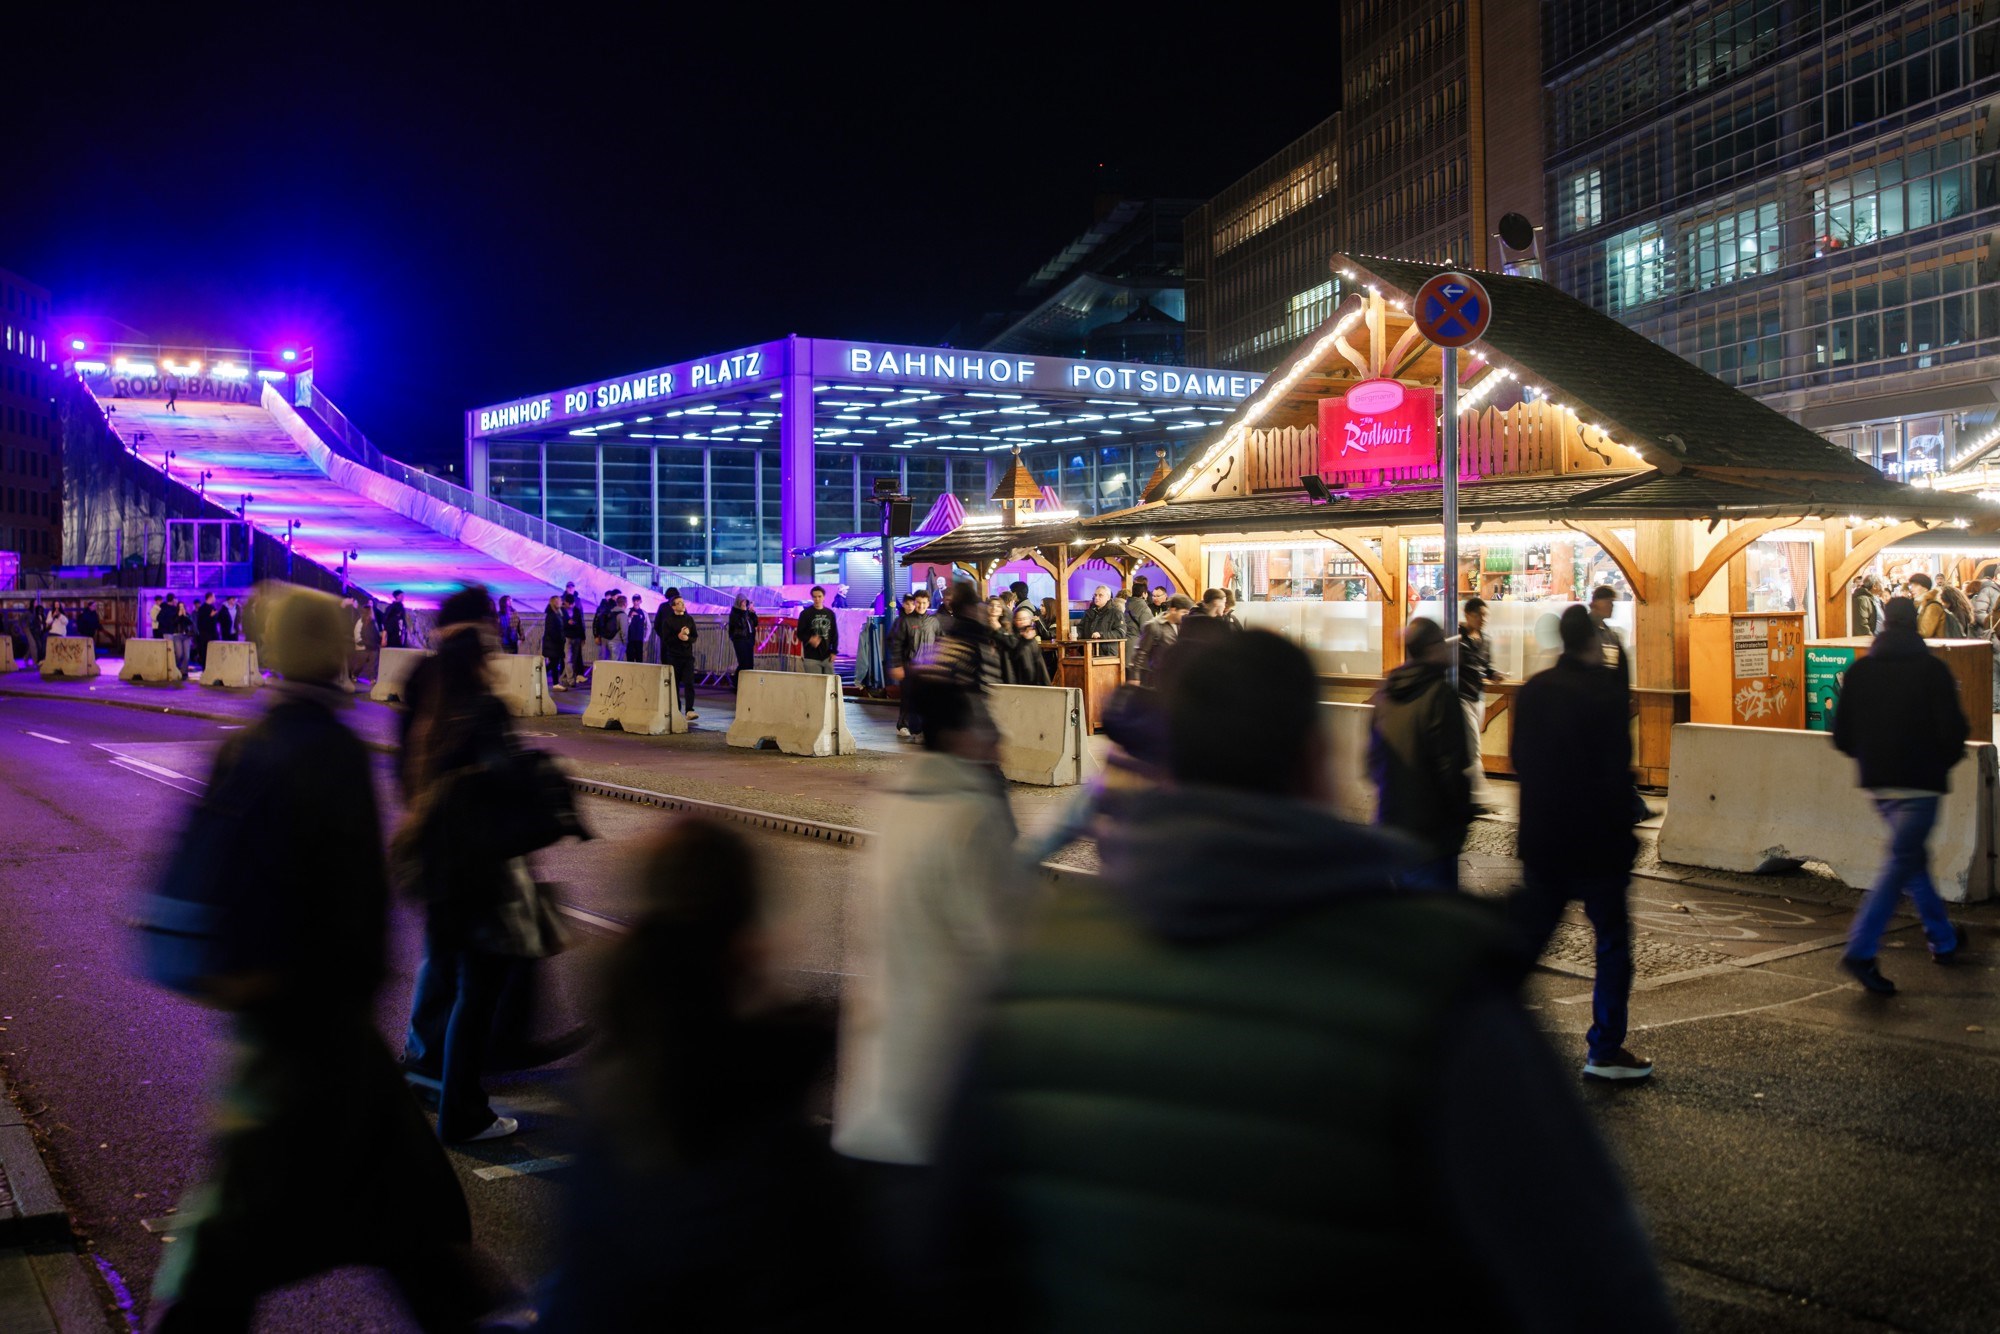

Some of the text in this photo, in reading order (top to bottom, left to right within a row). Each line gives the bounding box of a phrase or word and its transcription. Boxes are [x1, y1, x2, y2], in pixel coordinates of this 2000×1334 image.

[851, 348, 1036, 383] BAHNHOF
[115, 375, 249, 401] RODLBAHN
[480, 352, 761, 431] BAHNHOF POTSDAMER PLATZ
[1341, 420, 1412, 457] Rodlwirt
[1784, 632, 1800, 646] 170
[1808, 652, 1847, 665] Rechargy
